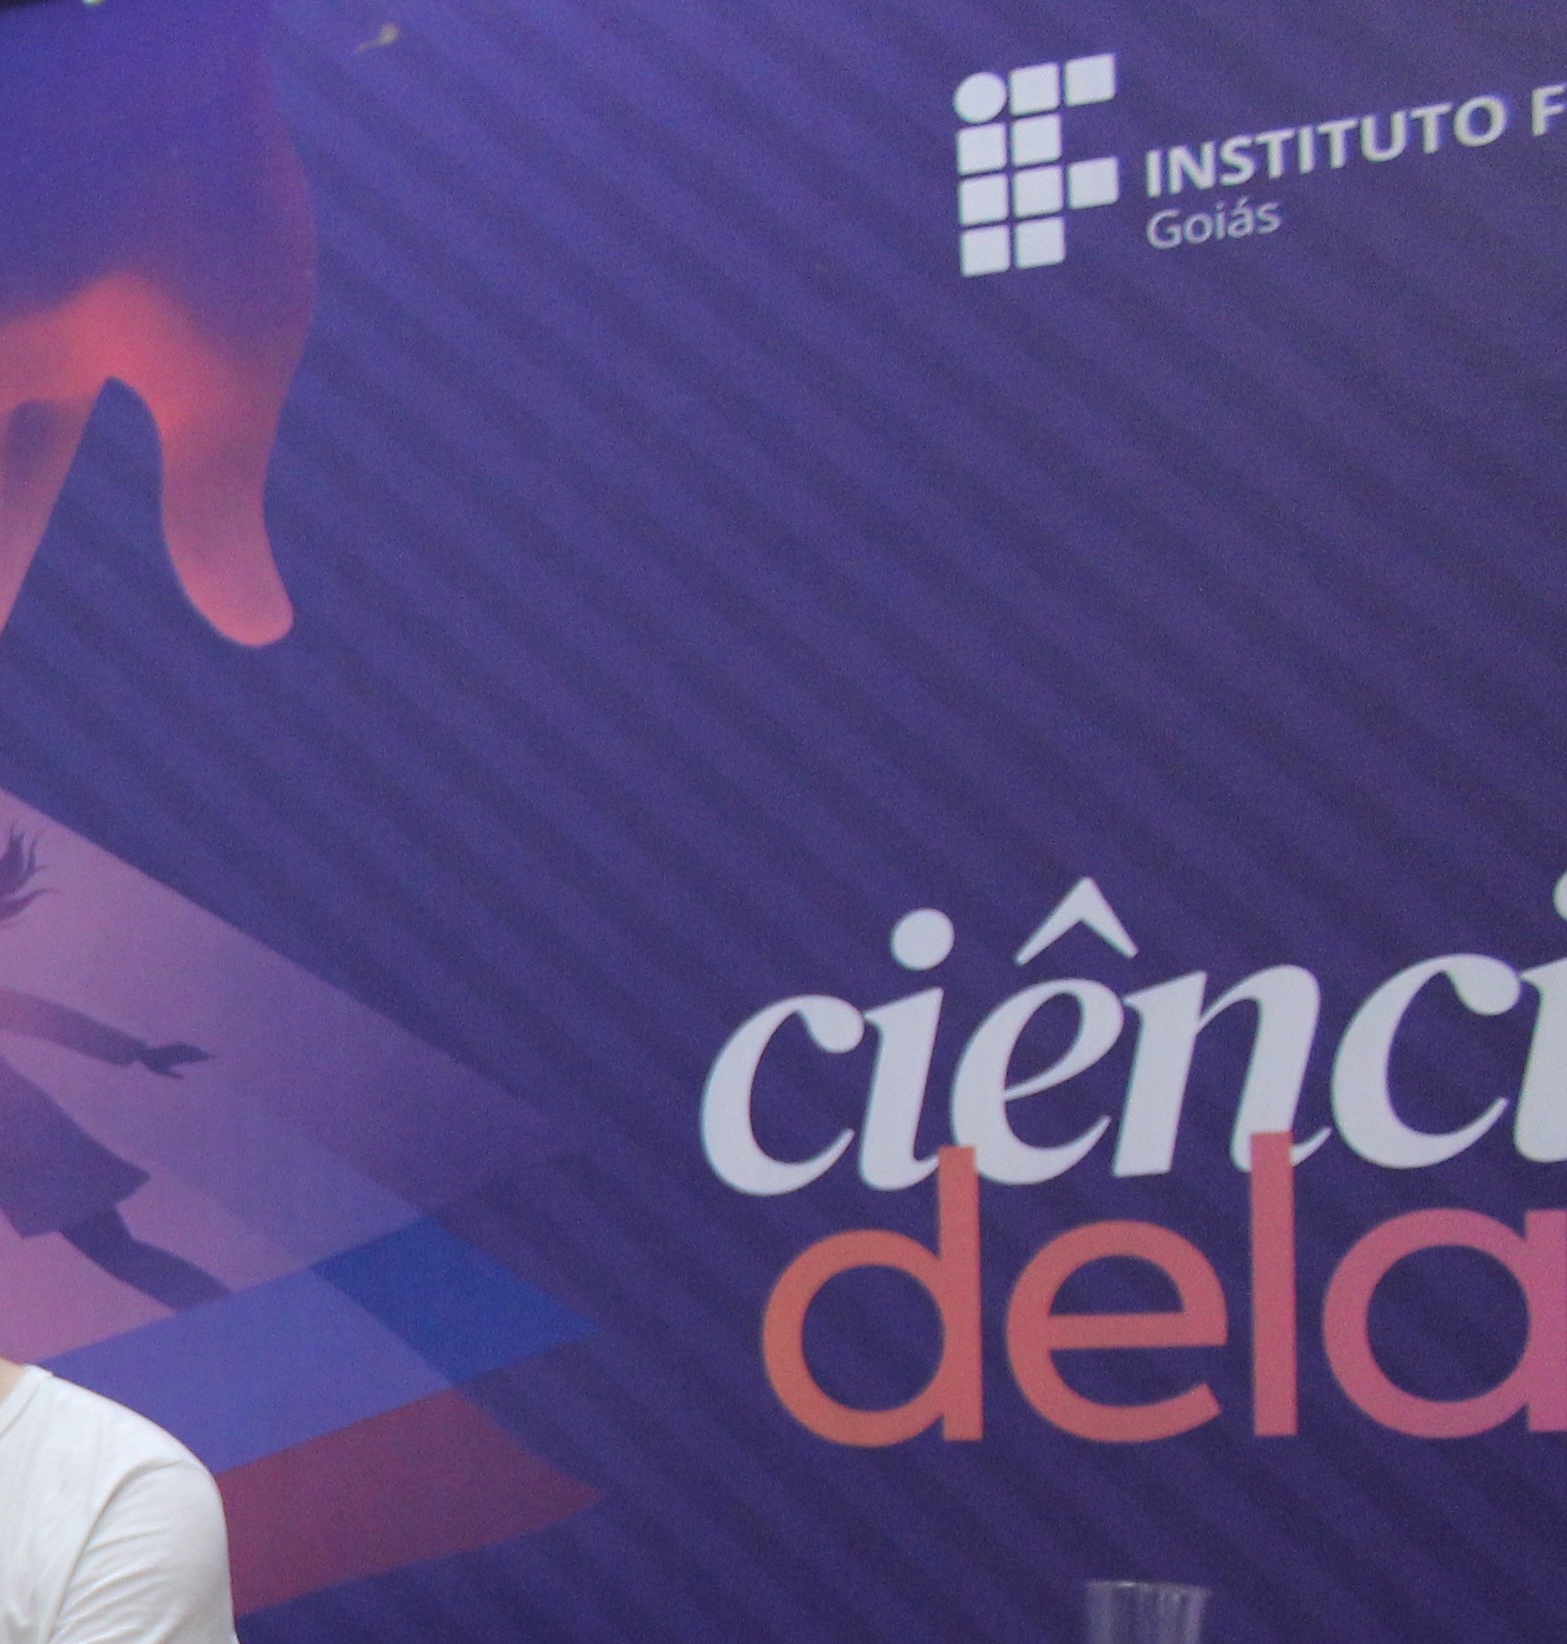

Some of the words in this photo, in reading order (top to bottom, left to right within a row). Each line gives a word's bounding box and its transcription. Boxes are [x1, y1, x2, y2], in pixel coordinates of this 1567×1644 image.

[1146, 95, 1507, 197] INSTITUTO
[1146, 197, 1282, 250] Goiás
[762, 1131, 1567, 1447] dela
